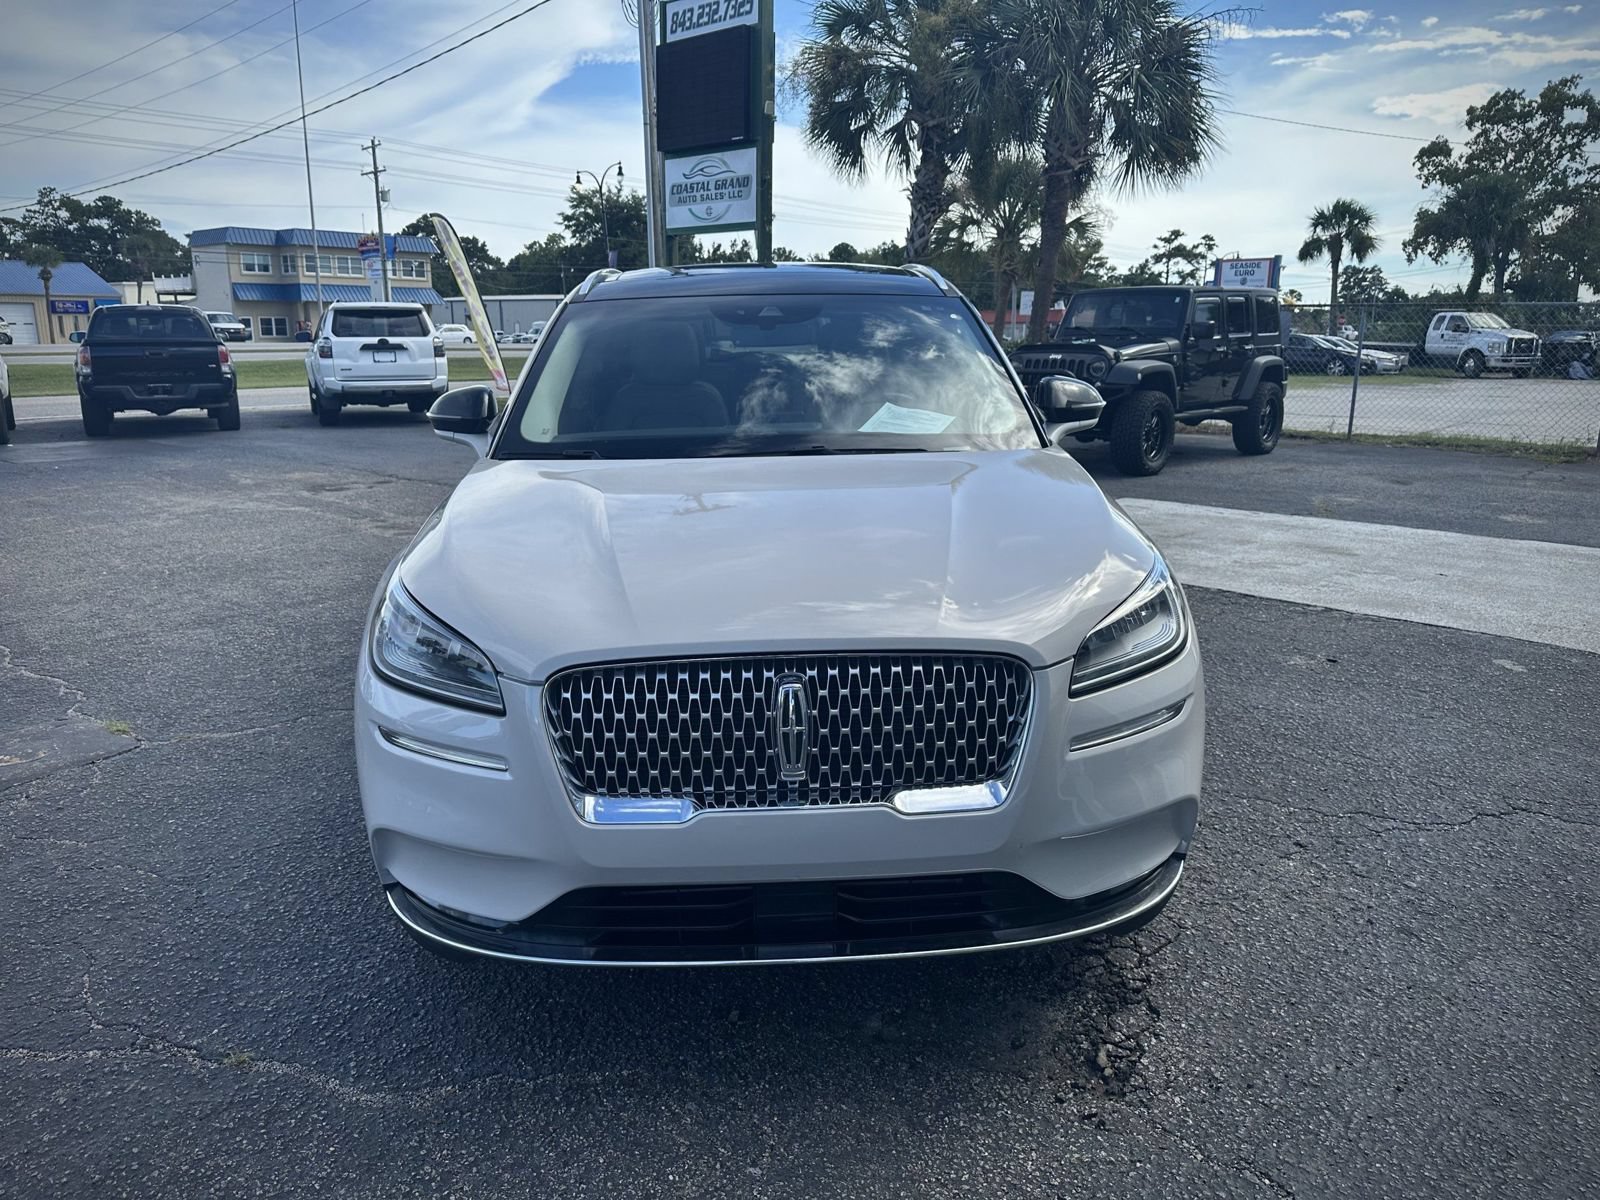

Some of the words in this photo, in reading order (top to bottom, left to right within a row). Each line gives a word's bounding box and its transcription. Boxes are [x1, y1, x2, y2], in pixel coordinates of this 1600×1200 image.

[670, 0, 754, 35] 843.232.7325
[671, 181, 711, 195] COASTAL
[714, 176, 750, 190] GRAND
[677, 195, 697, 204] AUTO
[728, 190, 743, 199] LLC
[1229, 262, 1262, 270] SEASIDE
